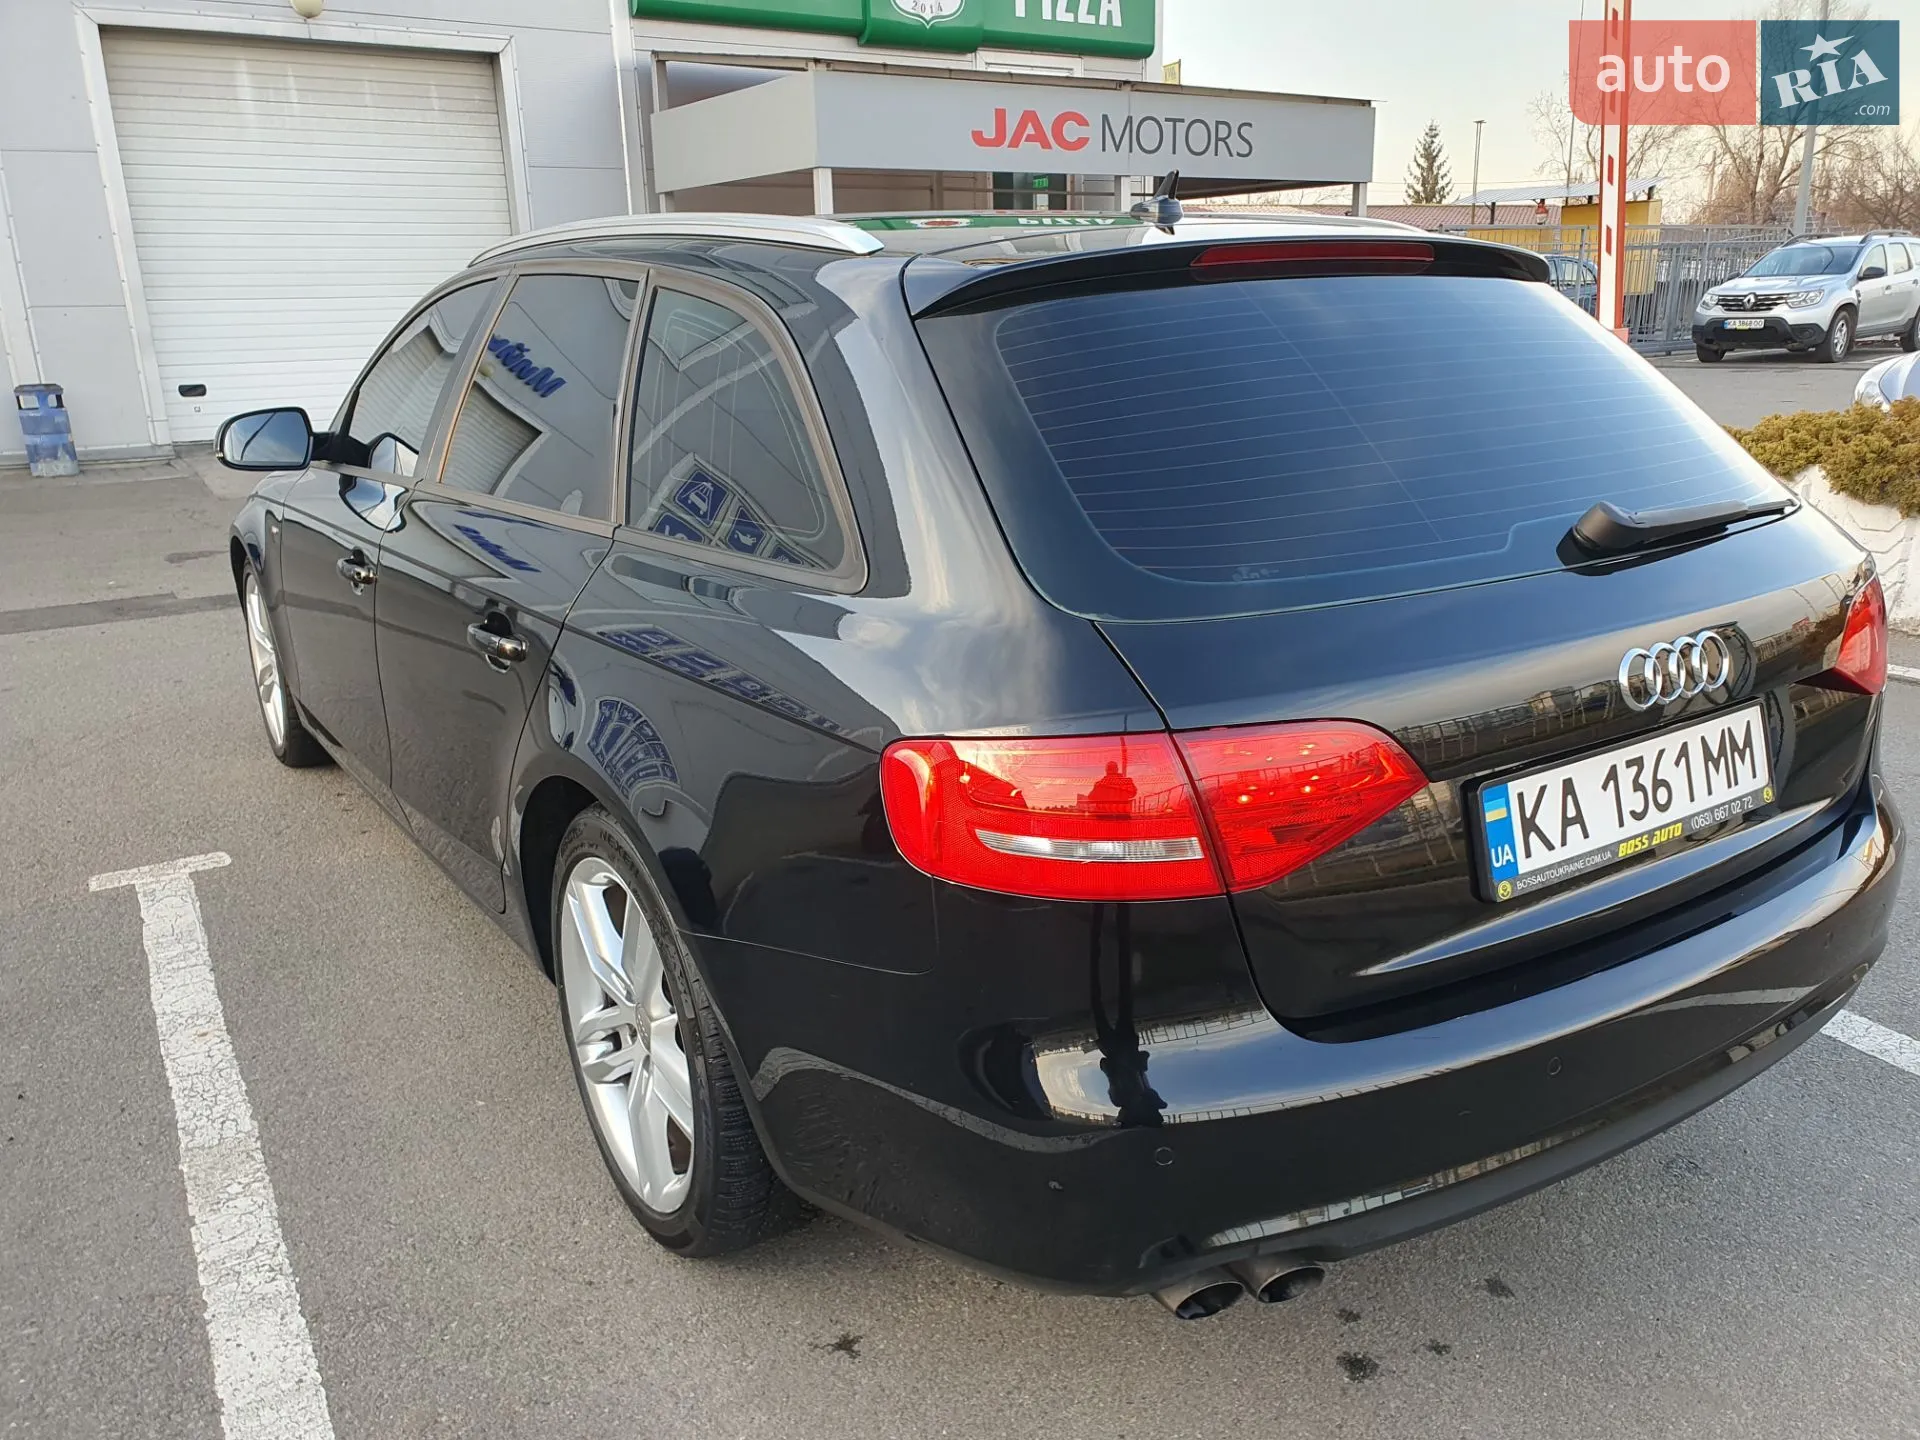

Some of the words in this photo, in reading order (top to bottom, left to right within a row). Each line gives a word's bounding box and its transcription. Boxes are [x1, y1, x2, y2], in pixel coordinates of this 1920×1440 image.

[971, 107, 1091, 151] JAC
[1101, 113, 1254, 158] MOTORS
[1517, 777, 1590, 859] KA
[1601, 741, 1695, 828] 1361
[1700, 719, 1757, 797] MM
[1690, 812, 1713, 830] (063)
[1714, 804, 1729, 821] 667
[1731, 802, 1743, 815] 02
[1742, 796, 1754, 810] 72
[1491, 844, 1515, 868] UA
[1618, 834, 1649, 858] BOSS
[1652, 822, 1683, 846] AUTO
